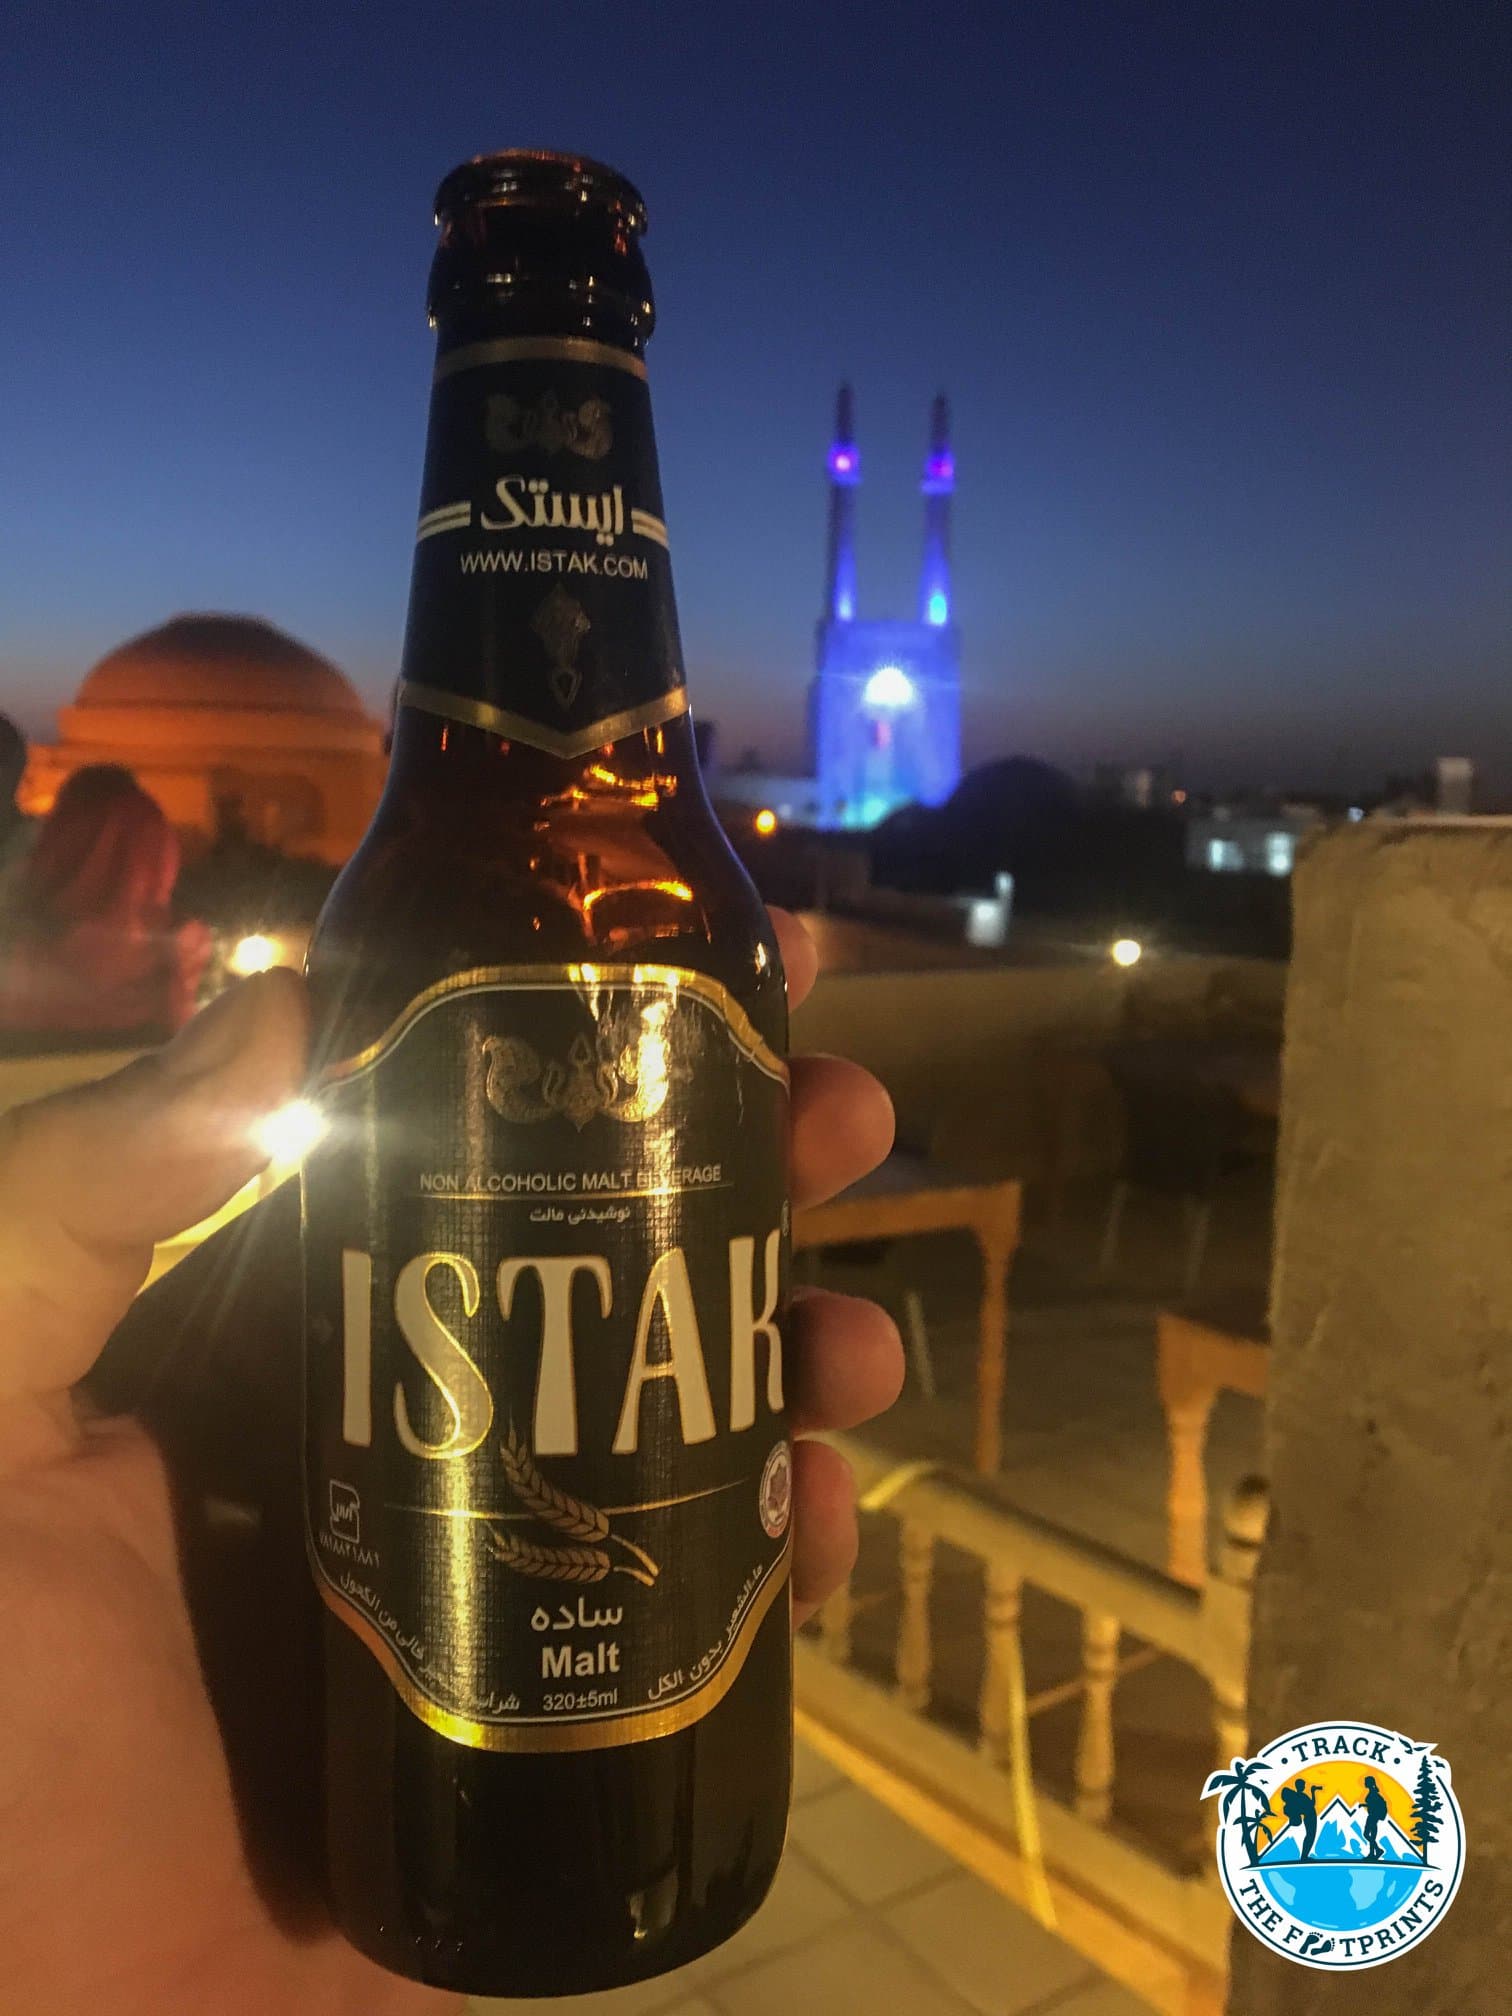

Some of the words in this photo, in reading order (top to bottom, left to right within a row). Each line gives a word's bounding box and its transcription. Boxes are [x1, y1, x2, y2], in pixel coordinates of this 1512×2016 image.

[479, 475, 624, 547] ایستک
[459, 549, 649, 580] WWW.ISTAK.COM
[419, 1173, 459, 1191] NON
[463, 1173, 577, 1192] ALCOHOLIC
[581, 1171, 632, 1190] MALT
[529, 1206, 565, 1222] مالت
[342, 1229, 785, 1460] ISTAK
[530, 1596, 624, 1632] ساده
[541, 1641, 621, 1679] Malt
[542, 1688, 618, 1712] 320±5ml
